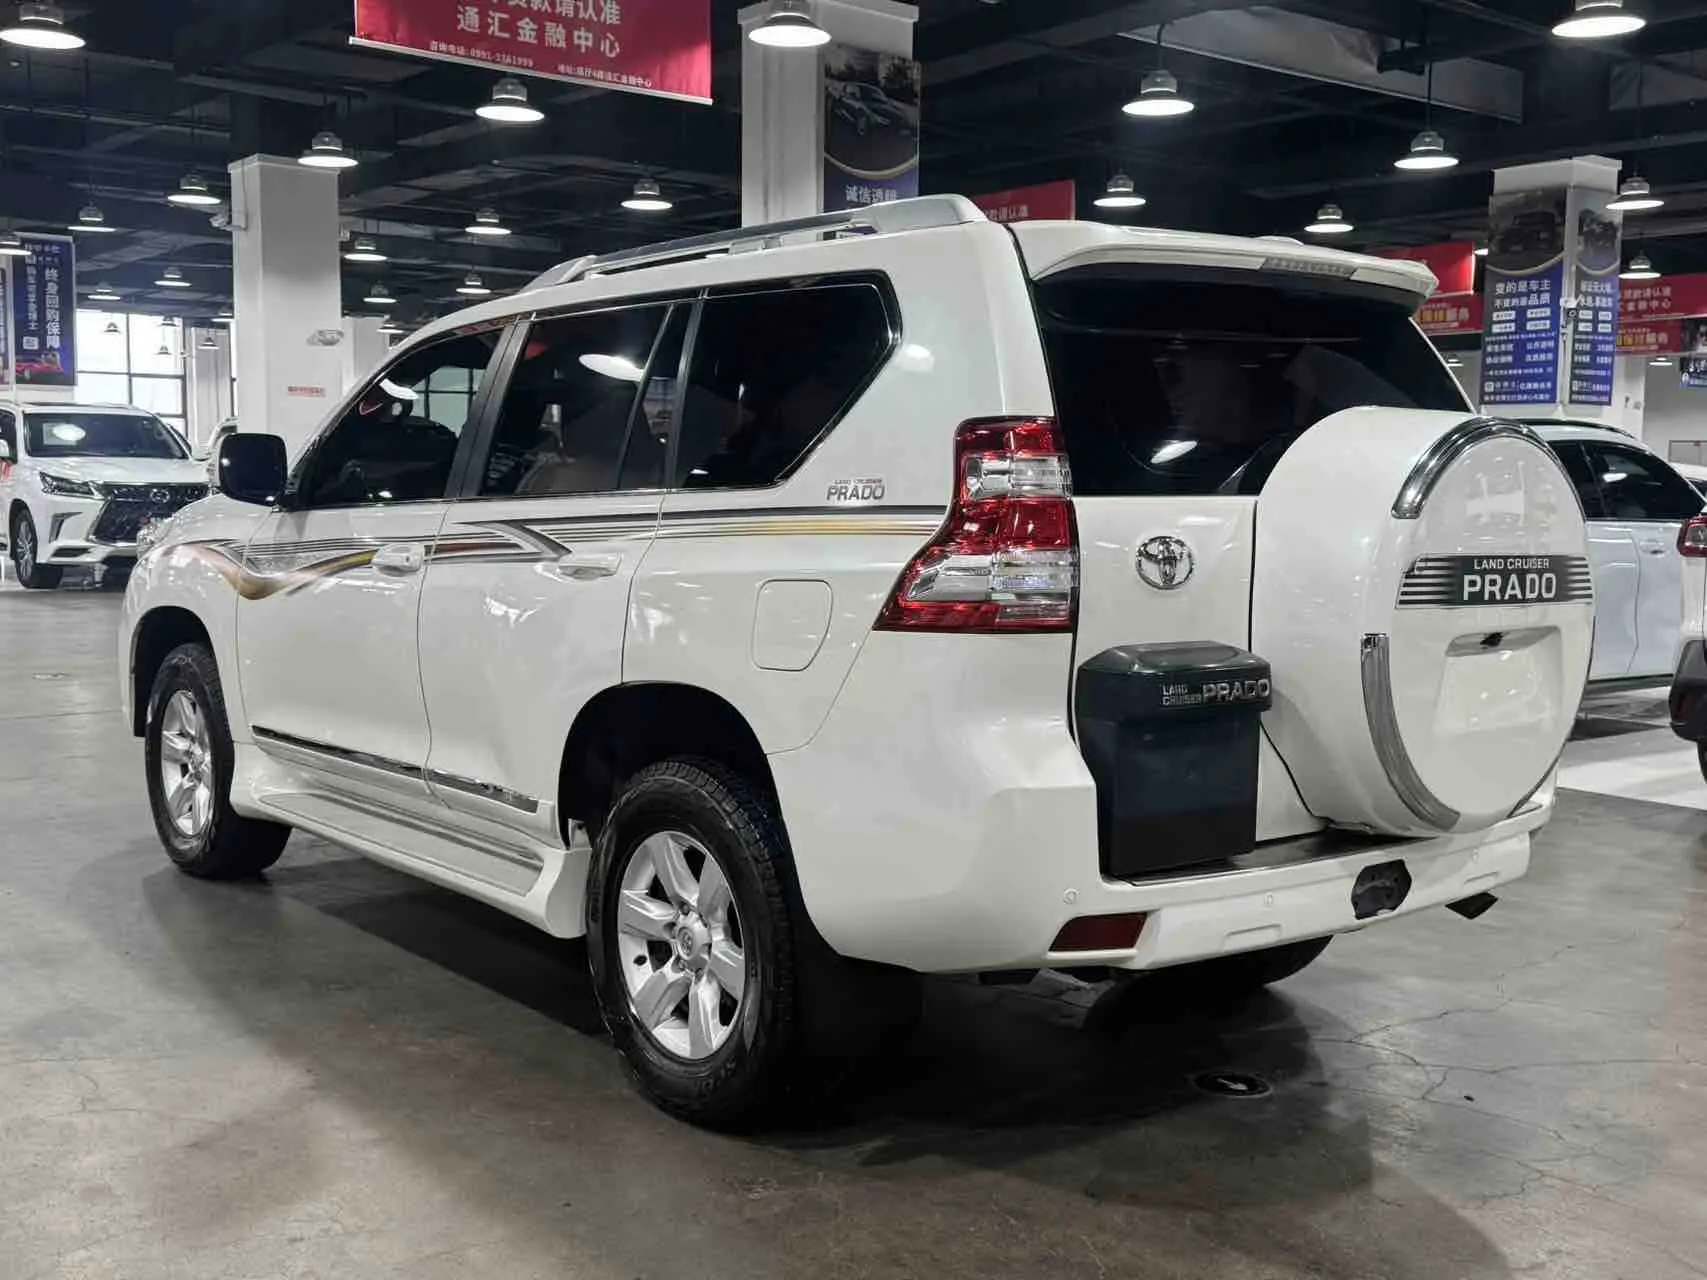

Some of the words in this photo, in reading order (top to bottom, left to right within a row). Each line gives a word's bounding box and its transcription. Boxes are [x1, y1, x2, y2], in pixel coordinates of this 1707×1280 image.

[457, 5, 620, 58] 通汇金融中心
[827, 485, 885, 501] PRADO
[1474, 558, 1505, 570] LAND
[1507, 557, 1550, 569] CRUISER
[1463, 573, 1557, 601] PRADO
[1162, 683, 1188, 696] LAND
[1202, 679, 1270, 702] PRADO
